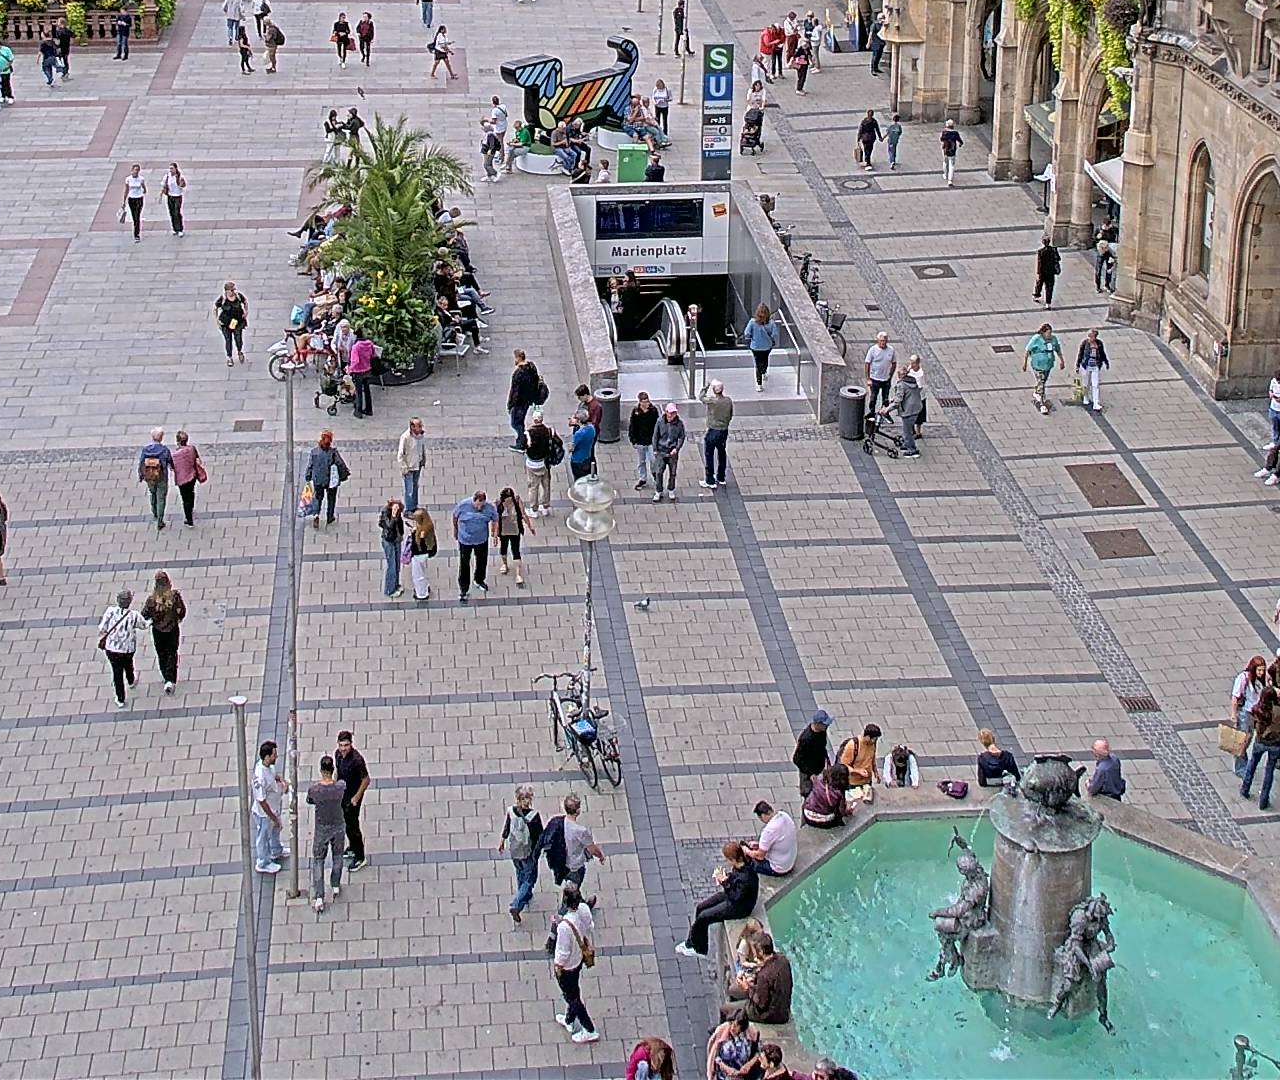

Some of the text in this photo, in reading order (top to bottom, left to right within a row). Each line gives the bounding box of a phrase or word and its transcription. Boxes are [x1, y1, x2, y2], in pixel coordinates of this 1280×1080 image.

[710, 47, 728, 70] S
[709, 76, 726, 97] U
[611, 244, 687, 258] Marienplatz
